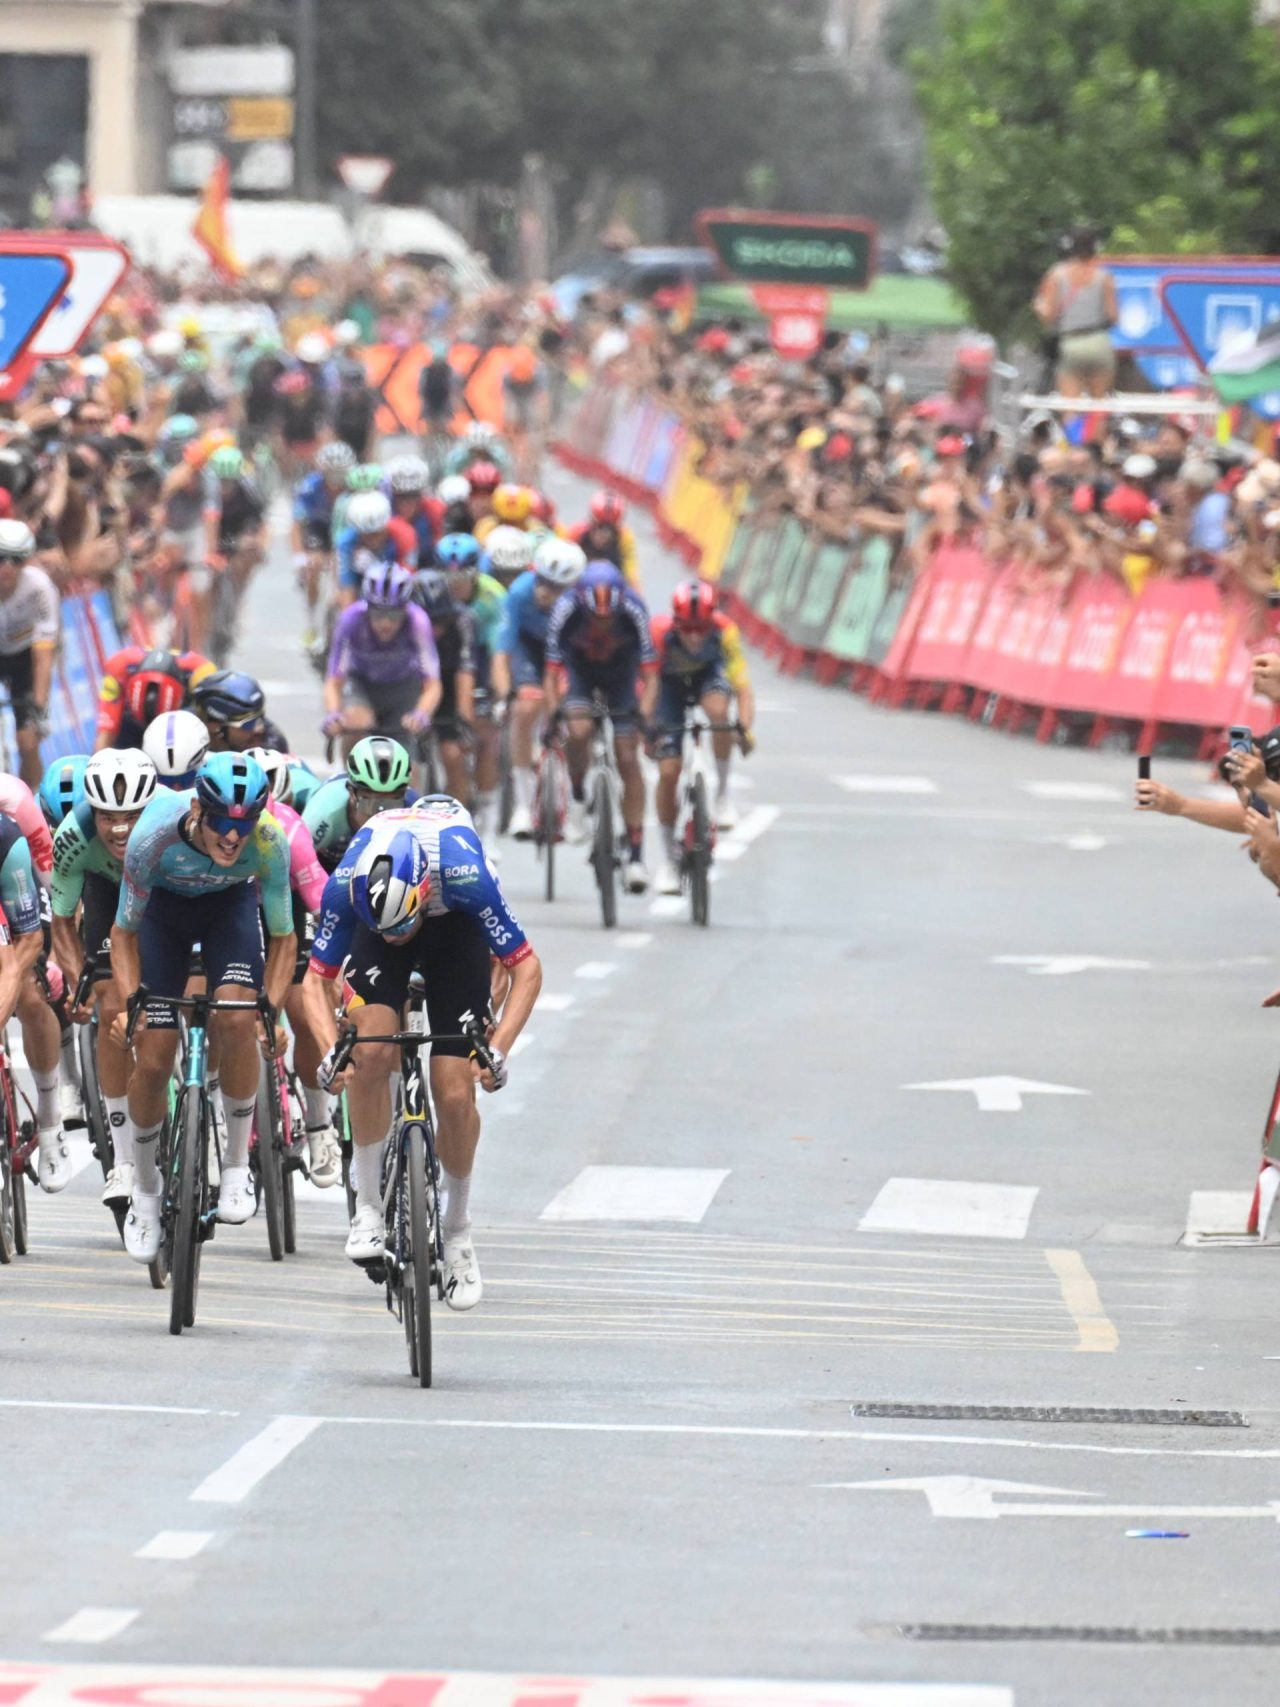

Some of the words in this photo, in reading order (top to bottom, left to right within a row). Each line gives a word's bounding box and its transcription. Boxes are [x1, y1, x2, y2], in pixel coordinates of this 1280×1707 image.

[444, 864, 480, 878] BORA
[314, 909, 340, 952] BOSS
[478, 906, 513, 946] BOSS
